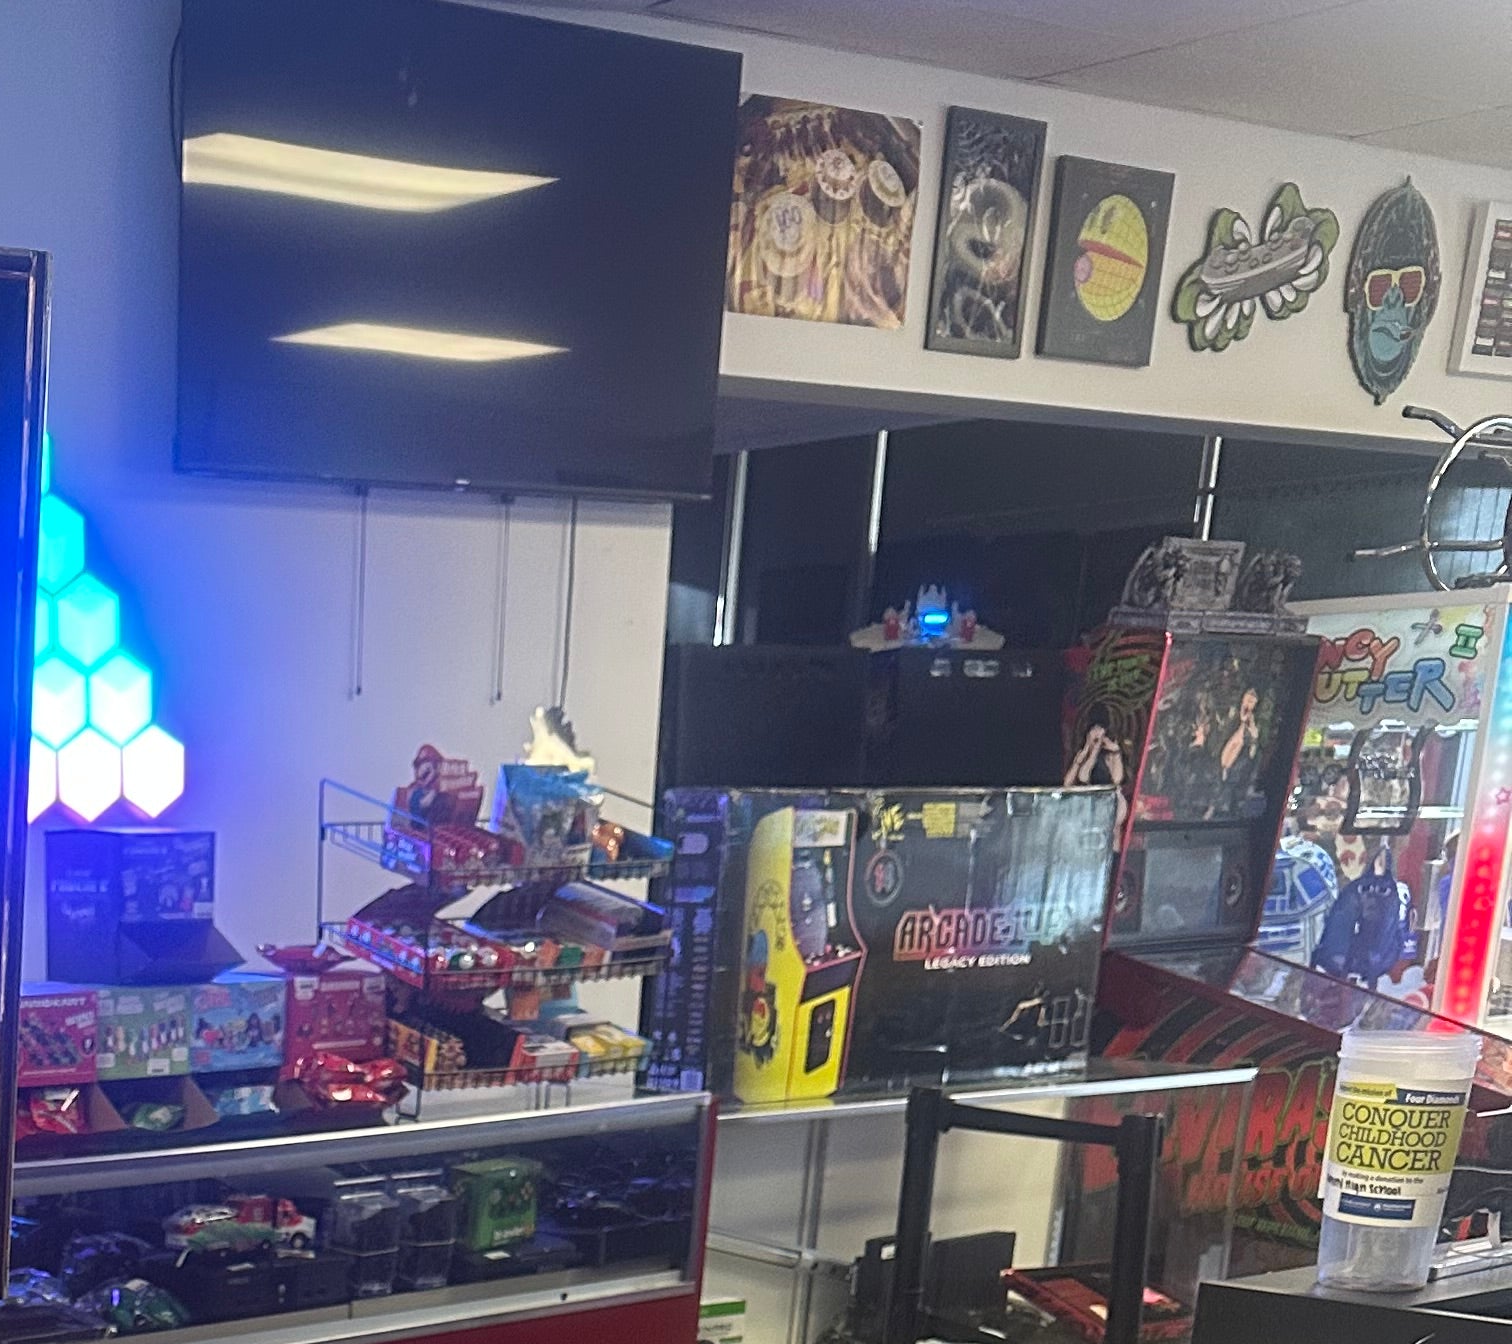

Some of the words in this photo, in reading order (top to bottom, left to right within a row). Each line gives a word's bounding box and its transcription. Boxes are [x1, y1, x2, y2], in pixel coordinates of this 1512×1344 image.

[1319, 627, 1401, 682] NCY
[1313, 657, 1456, 715] UTTER
[924, 955, 976, 970] LEGACY
[978, 953, 1032, 968] EDITION
[1405, 1093, 1426, 1104] Four
[1342, 1102, 1452, 1130] CONQUER
[1338, 1122, 1448, 1148] CHILDHOOD
[1336, 1140, 1442, 1172] CANCER
